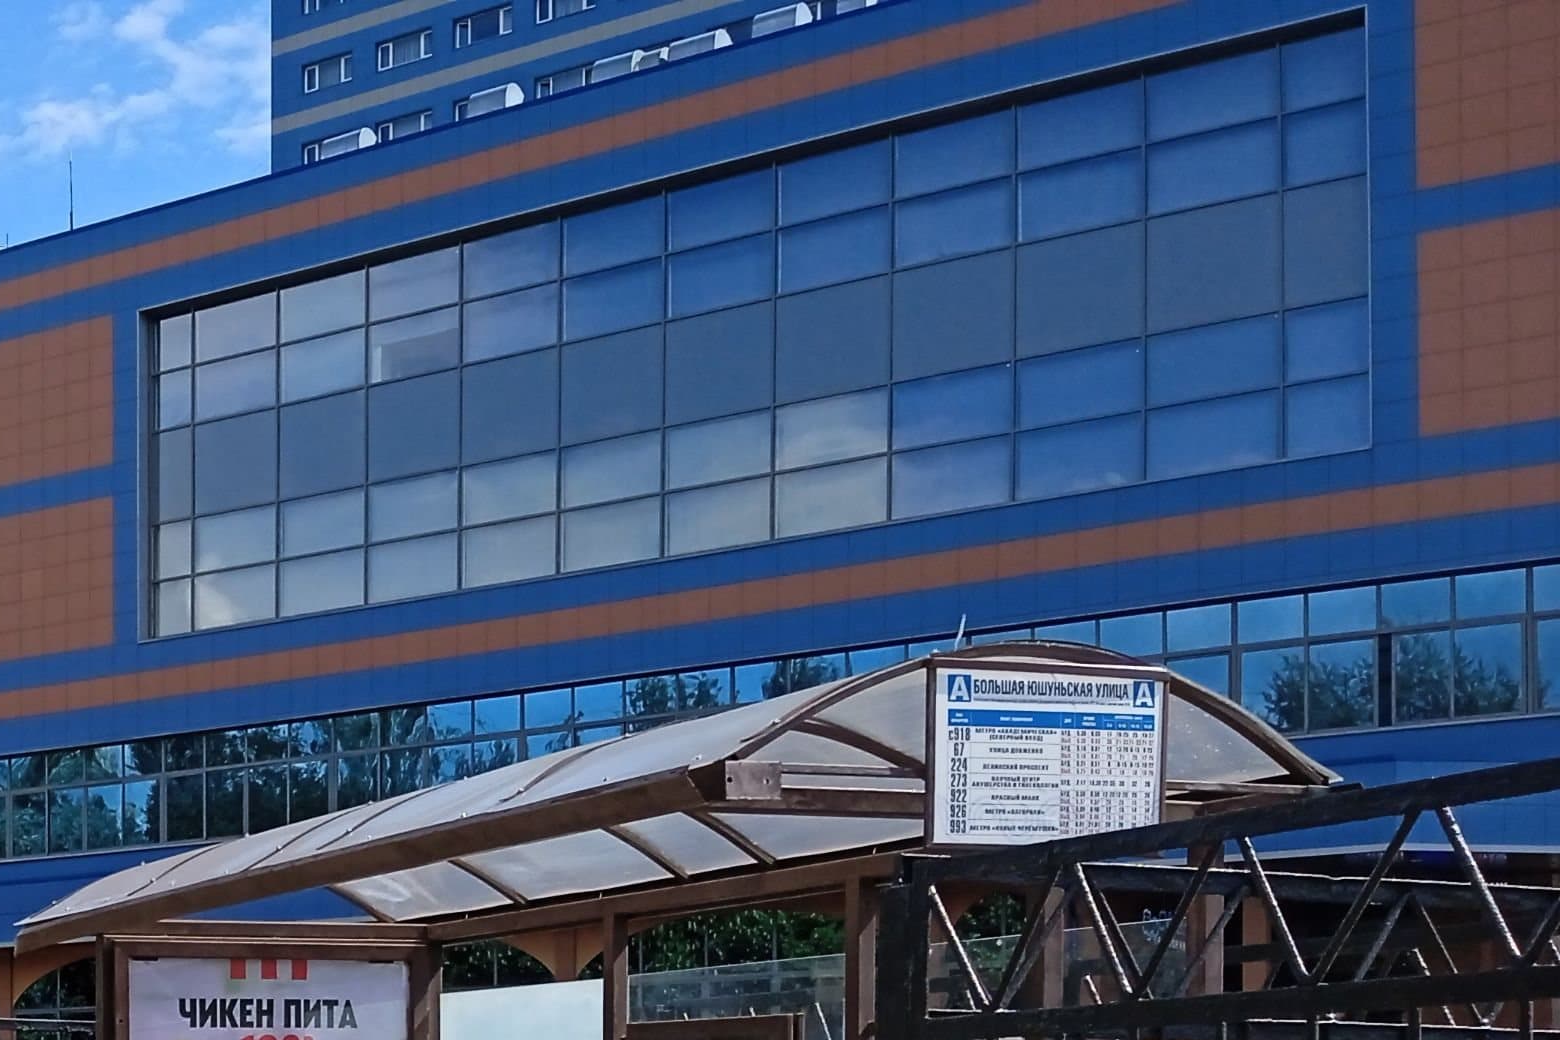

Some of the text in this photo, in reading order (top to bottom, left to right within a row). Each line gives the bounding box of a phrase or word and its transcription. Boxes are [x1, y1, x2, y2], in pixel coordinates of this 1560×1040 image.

[973, 679, 1025, 695] БОЛЬШАЯ
[1027, 680, 1093, 697] ЮШУНЬСКАЯ
[1095, 683, 1129, 700] УЛИЦА
[948, 727, 971, 741] с918
[953, 742, 965, 756] 67
[950, 757, 968, 772] 224
[950, 773, 968, 788] 273
[950, 789, 967, 803] 922
[950, 804, 967, 818] 926
[950, 820, 966, 834] 993
[178, 998, 357, 1029] ЧИКЕН ПИТА
